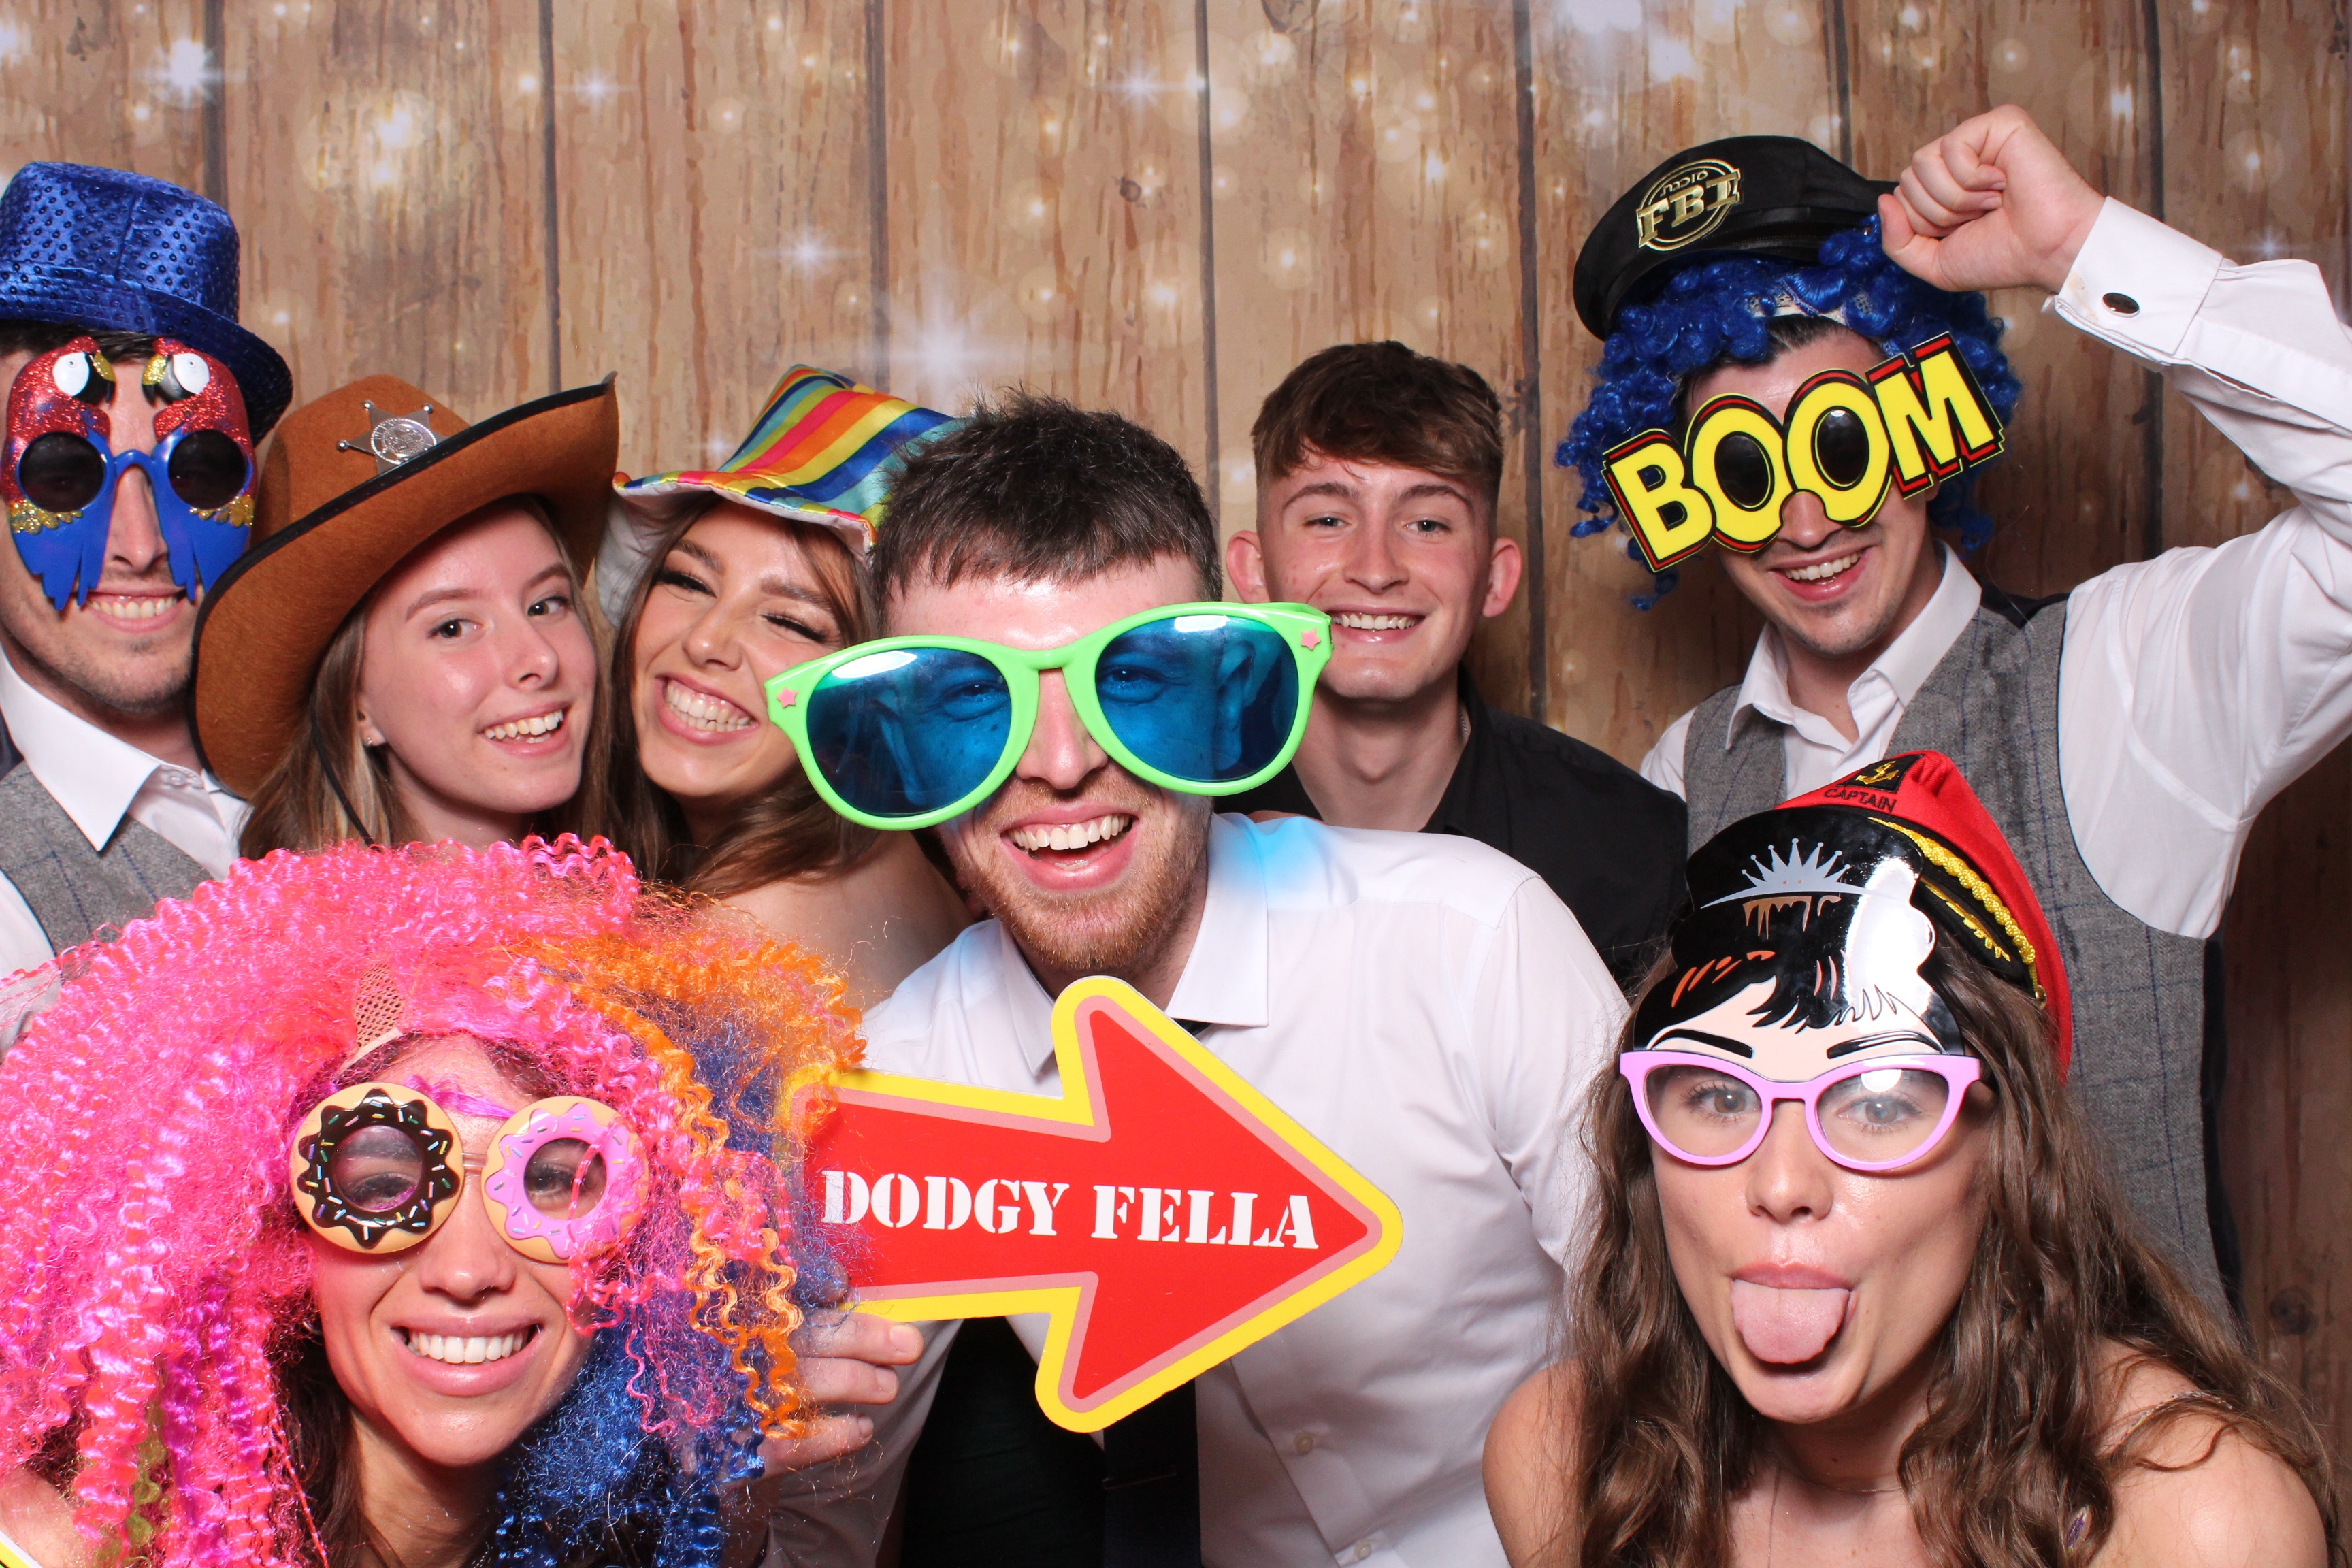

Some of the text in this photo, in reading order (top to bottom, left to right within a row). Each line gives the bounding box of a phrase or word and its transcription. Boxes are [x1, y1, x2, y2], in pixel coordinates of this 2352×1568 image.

[1637, 170, 1740, 247] FBI
[1605, 337, 2001, 570] BOOM
[1823, 788, 1897, 813] CAPTAIN
[819, 1169, 1320, 1250] DODGY FELLA
